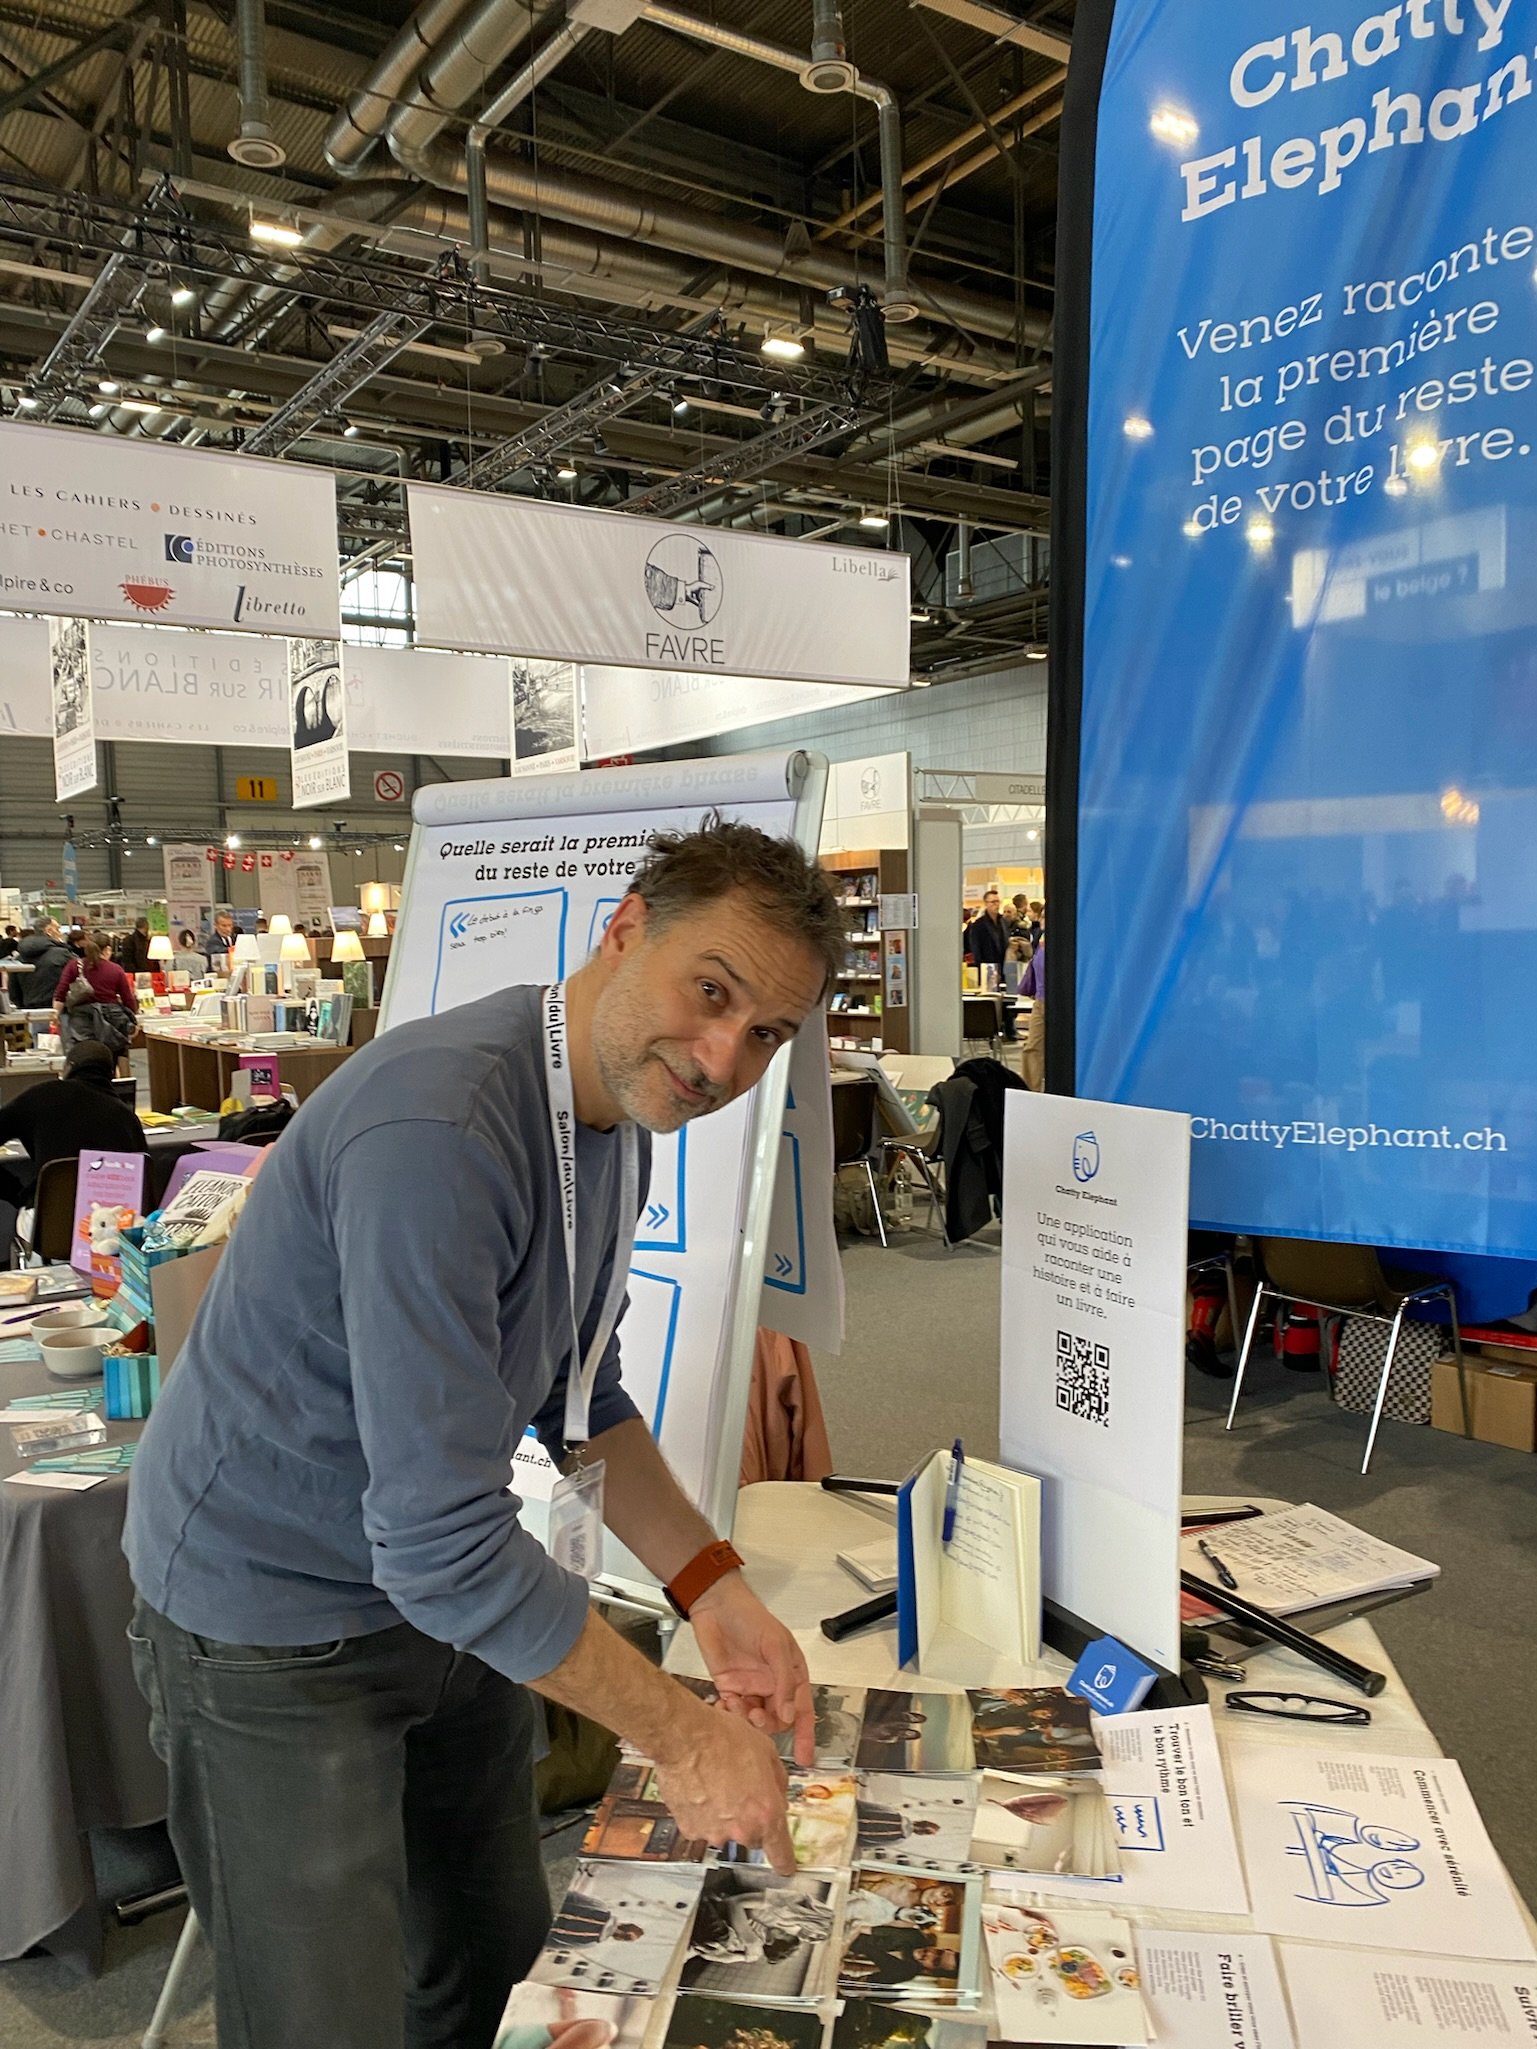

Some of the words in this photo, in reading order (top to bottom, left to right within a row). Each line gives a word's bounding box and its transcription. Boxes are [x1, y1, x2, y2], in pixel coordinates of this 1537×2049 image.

[1230, 0, 1512, 108] Chatty
[1181, 45, 1537, 222] Elephan
[1177, 293, 1323, 360] Venez
[1342, 224, 1534, 315] raconte
[1219, 373, 1262, 413] la
[1275, 300, 1499, 404] première
[1190, 416, 1307, 485] page
[1324, 404, 1386, 447] du
[1394, 357, 1534, 428] reste
[11, 483, 45, 498] LES
[56, 490, 141, 511] CAHIERS
[169, 504, 257, 526] DESSINÉS
[1192, 496, 1242, 534] de
[1256, 463, 1375, 516] votre
[51, 529, 139, 550] CHASTEL
[196, 538, 265, 559] ÉDITIONS
[196, 555, 324, 578] PHOTOSYNTHÈSES
[832, 557, 886, 578] Libella
[40, 578, 50, 592] &
[54, 583, 74, 595] co
[233, 585, 306, 623] libretto
[645, 633, 725, 665] FAVRE
[248, 779, 265, 798] 11
[439, 840, 495, 860] Quelle
[499, 833, 555, 855] serait
[559, 836, 580, 851] la
[583, 828, 656, 855] premiè
[475, 864, 498, 881] du
[503, 861, 550, 880] reste
[555, 860, 578, 878] de
[584, 858, 637, 877] votre
[1189, 1116, 1509, 1152] ChattyElephant.ch
[1055, 1185, 1081, 1199] Chatty
[1081, 1190, 1118, 1206] Elephant
[1037, 1211, 1060, 1228] Une
[1063, 1221, 1133, 1247] application
[1037, 1233, 1056, 1246] qui
[1059, 1238, 1089, 1255] vous
[1092, 1246, 1119, 1264] aide
[1122, 1252, 1132, 1267] à
[1044, 1253, 1094, 1276] raconter
[1097, 1268, 1122, 1284] une
[1032, 1265, 1077, 1289] histoire
[1080, 1281, 1091, 1294] et
[1094, 1284, 1103, 1298] à
[1105, 1288, 1136, 1308] faire
[1056, 1294, 1073, 1308] un
[1076, 1298, 1107, 1319] livre.
[1153, 1725, 1164, 1735] le
[1155, 1736, 1166, 1756] bon
[1169, 1723, 1183, 1764] Trouver
[1155, 1758, 1171, 1794] rythme
[1175, 1766, 1187, 1776] le
[1177, 1778, 1189, 1797] bon
[1180, 1799, 1191, 1815] ton
[1182, 1818, 1195, 1828] et
[1413, 1769, 1442, 1826] Commencer
[1434, 1827, 1451, 1852] avec
[1443, 1853, 1473, 1897] sérénité
[1217, 1953, 1236, 1989] Faire
[1225, 1993, 1244, 2037] briller
[1514, 1986, 1537, 2031] Suivre
